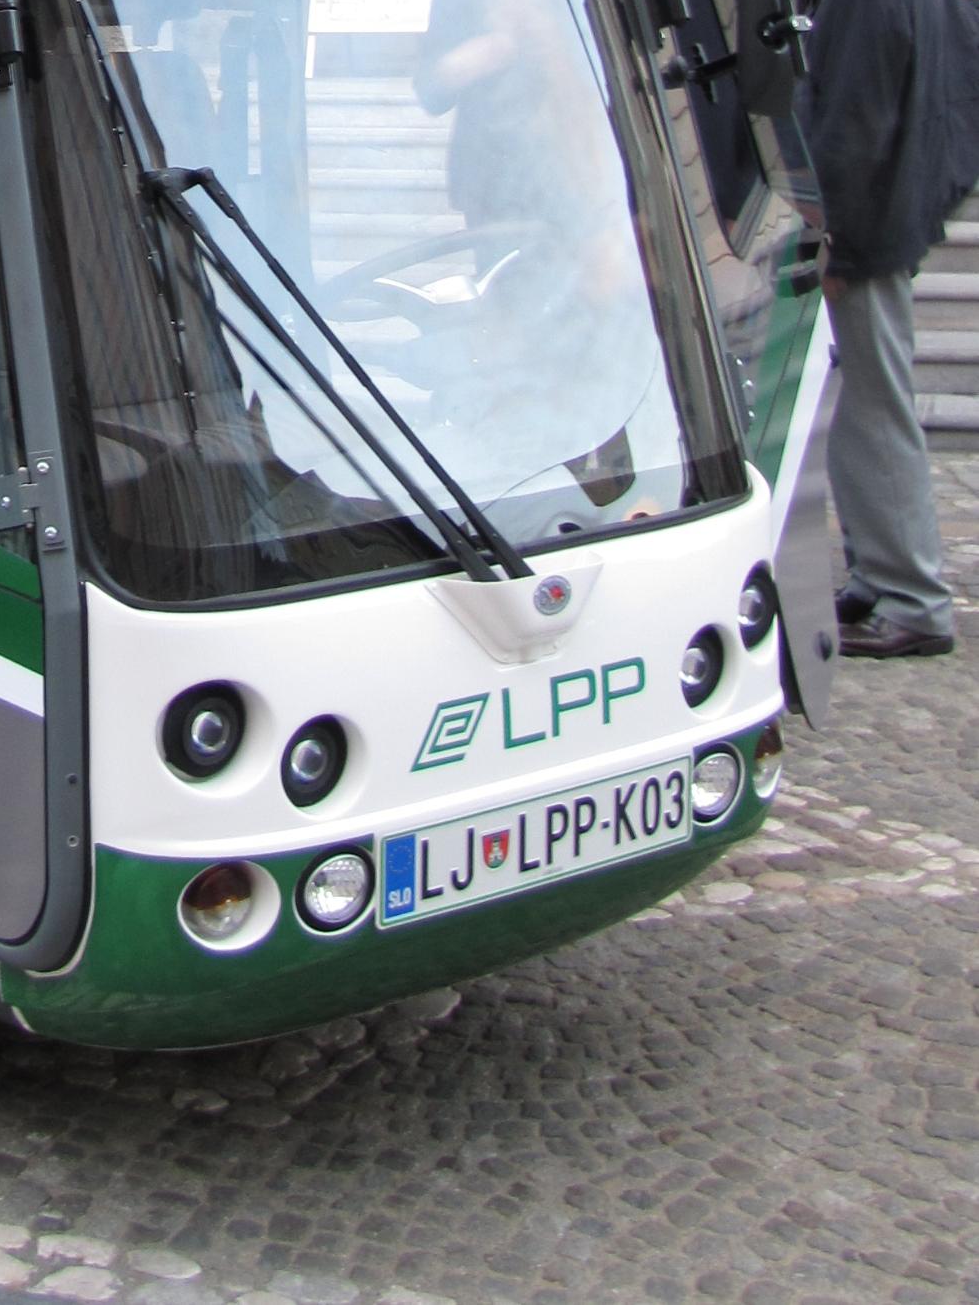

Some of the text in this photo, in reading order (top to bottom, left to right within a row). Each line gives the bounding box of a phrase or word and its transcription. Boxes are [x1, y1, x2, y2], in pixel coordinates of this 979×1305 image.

[501, 656, 647, 750] LPP
[421, 770, 685, 901] LJ LPP-K03
[387, 887, 412, 910] SLO
